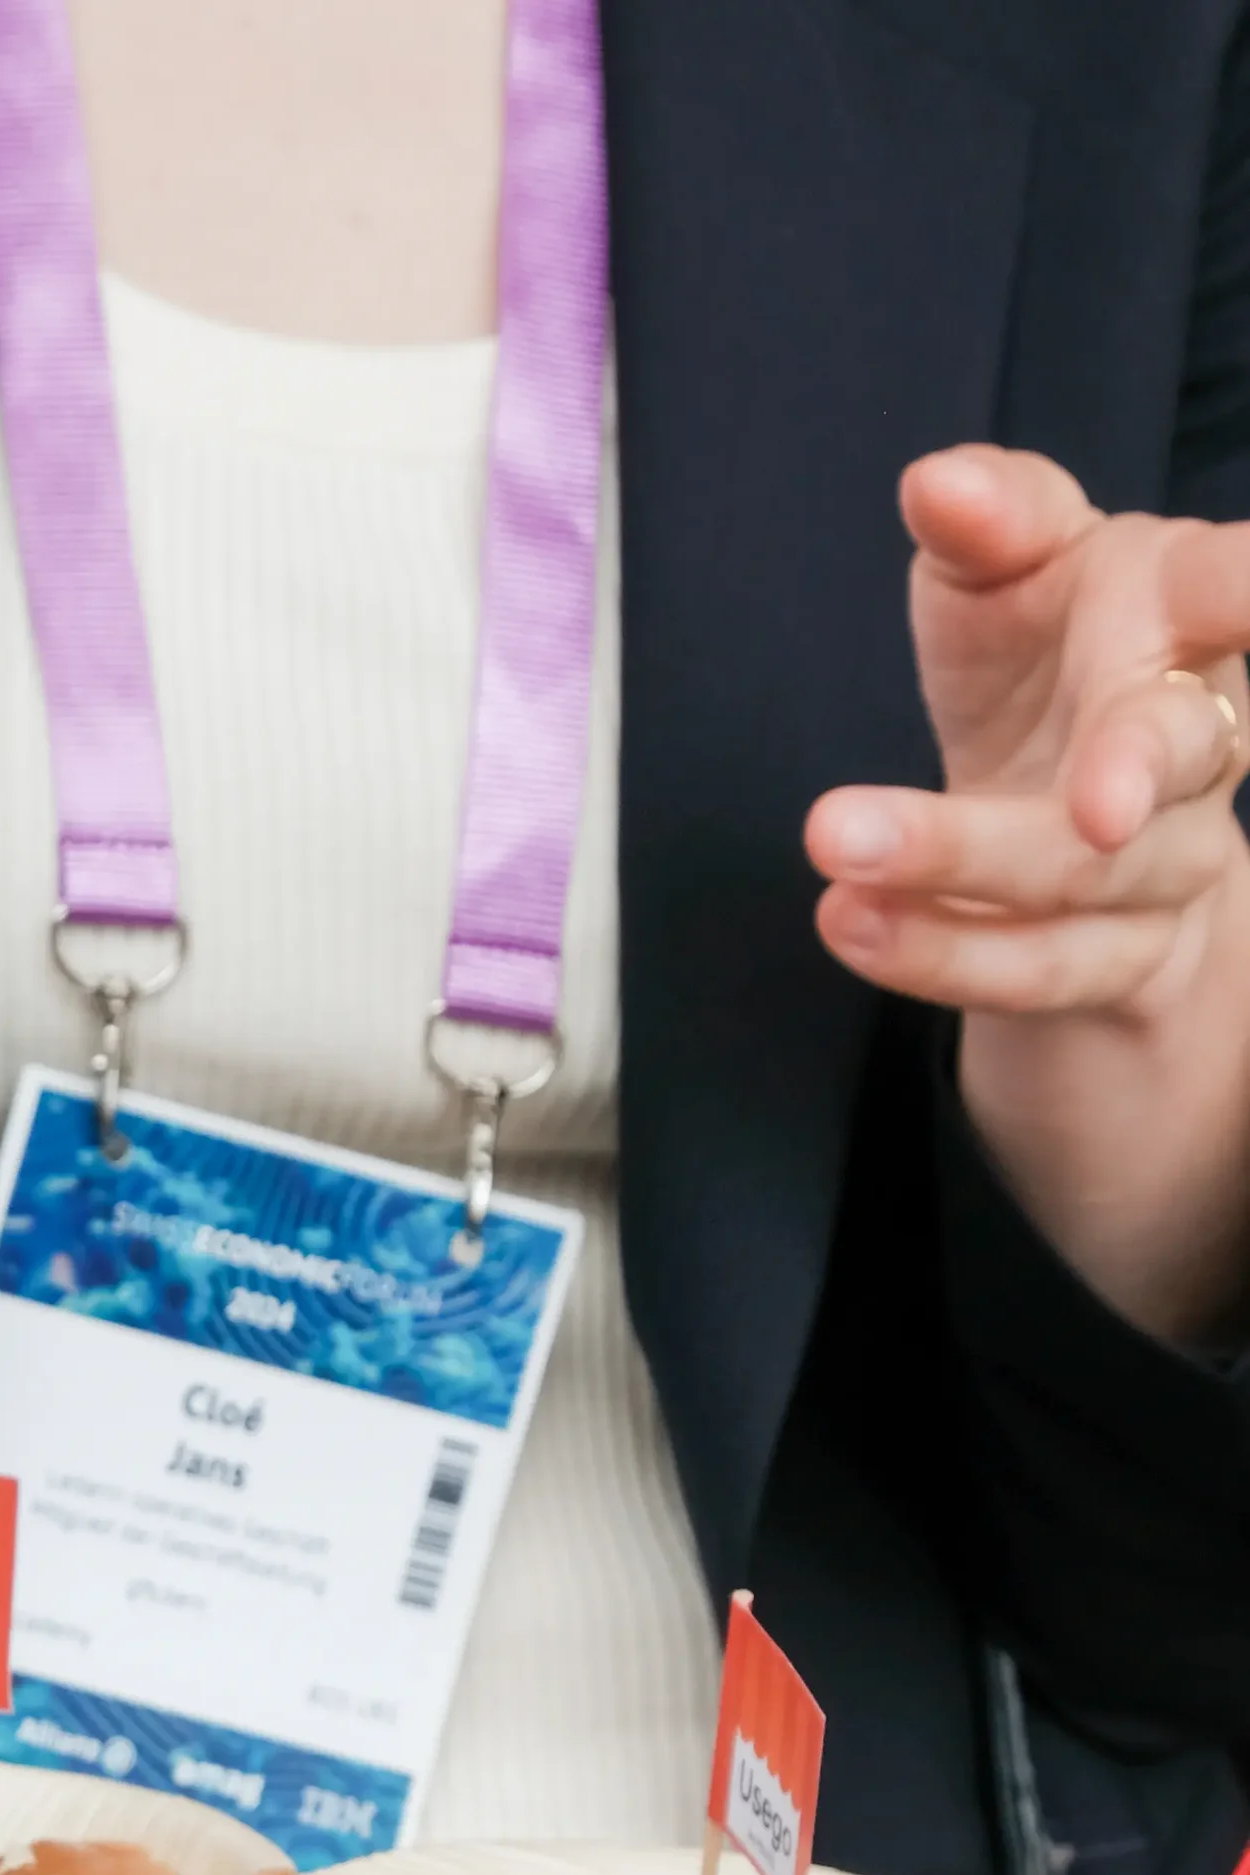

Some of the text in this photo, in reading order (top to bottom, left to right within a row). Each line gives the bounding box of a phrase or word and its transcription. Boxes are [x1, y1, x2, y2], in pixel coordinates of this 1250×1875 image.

[181, 1382, 264, 1433] Cloé
[166, 1440, 248, 1488] Jans
[739, 1758, 792, 1857] Usego
